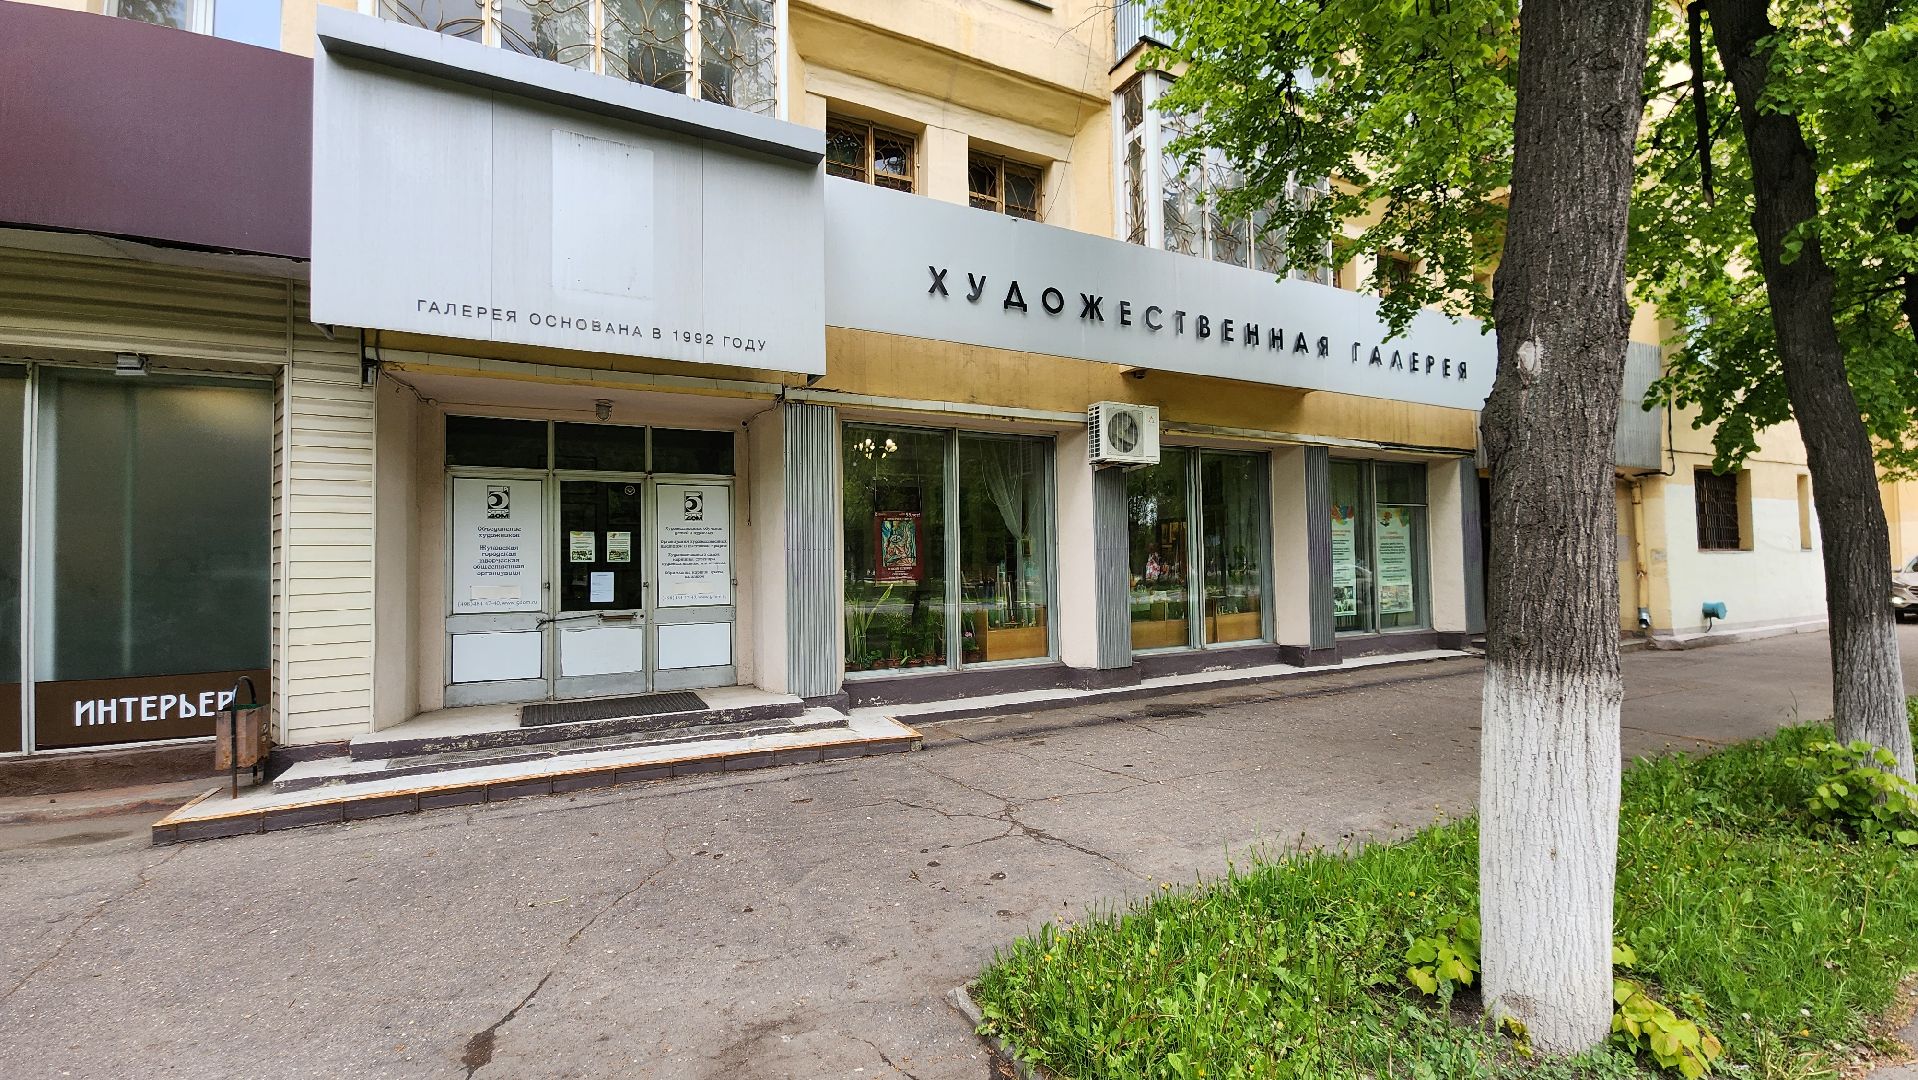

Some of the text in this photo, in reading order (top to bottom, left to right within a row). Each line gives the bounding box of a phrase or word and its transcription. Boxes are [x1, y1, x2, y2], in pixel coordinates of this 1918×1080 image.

[417, 299, 767, 352] ГАЛЕРЕЯ ОСНОВАНА В 1992 ГОДУ
[928, 265, 1467, 380] ХУДОЖЕСТВЕННАЯ ГАЛЕРЕЯ
[75, 691, 236, 727] ИНТЕРЬЕР
